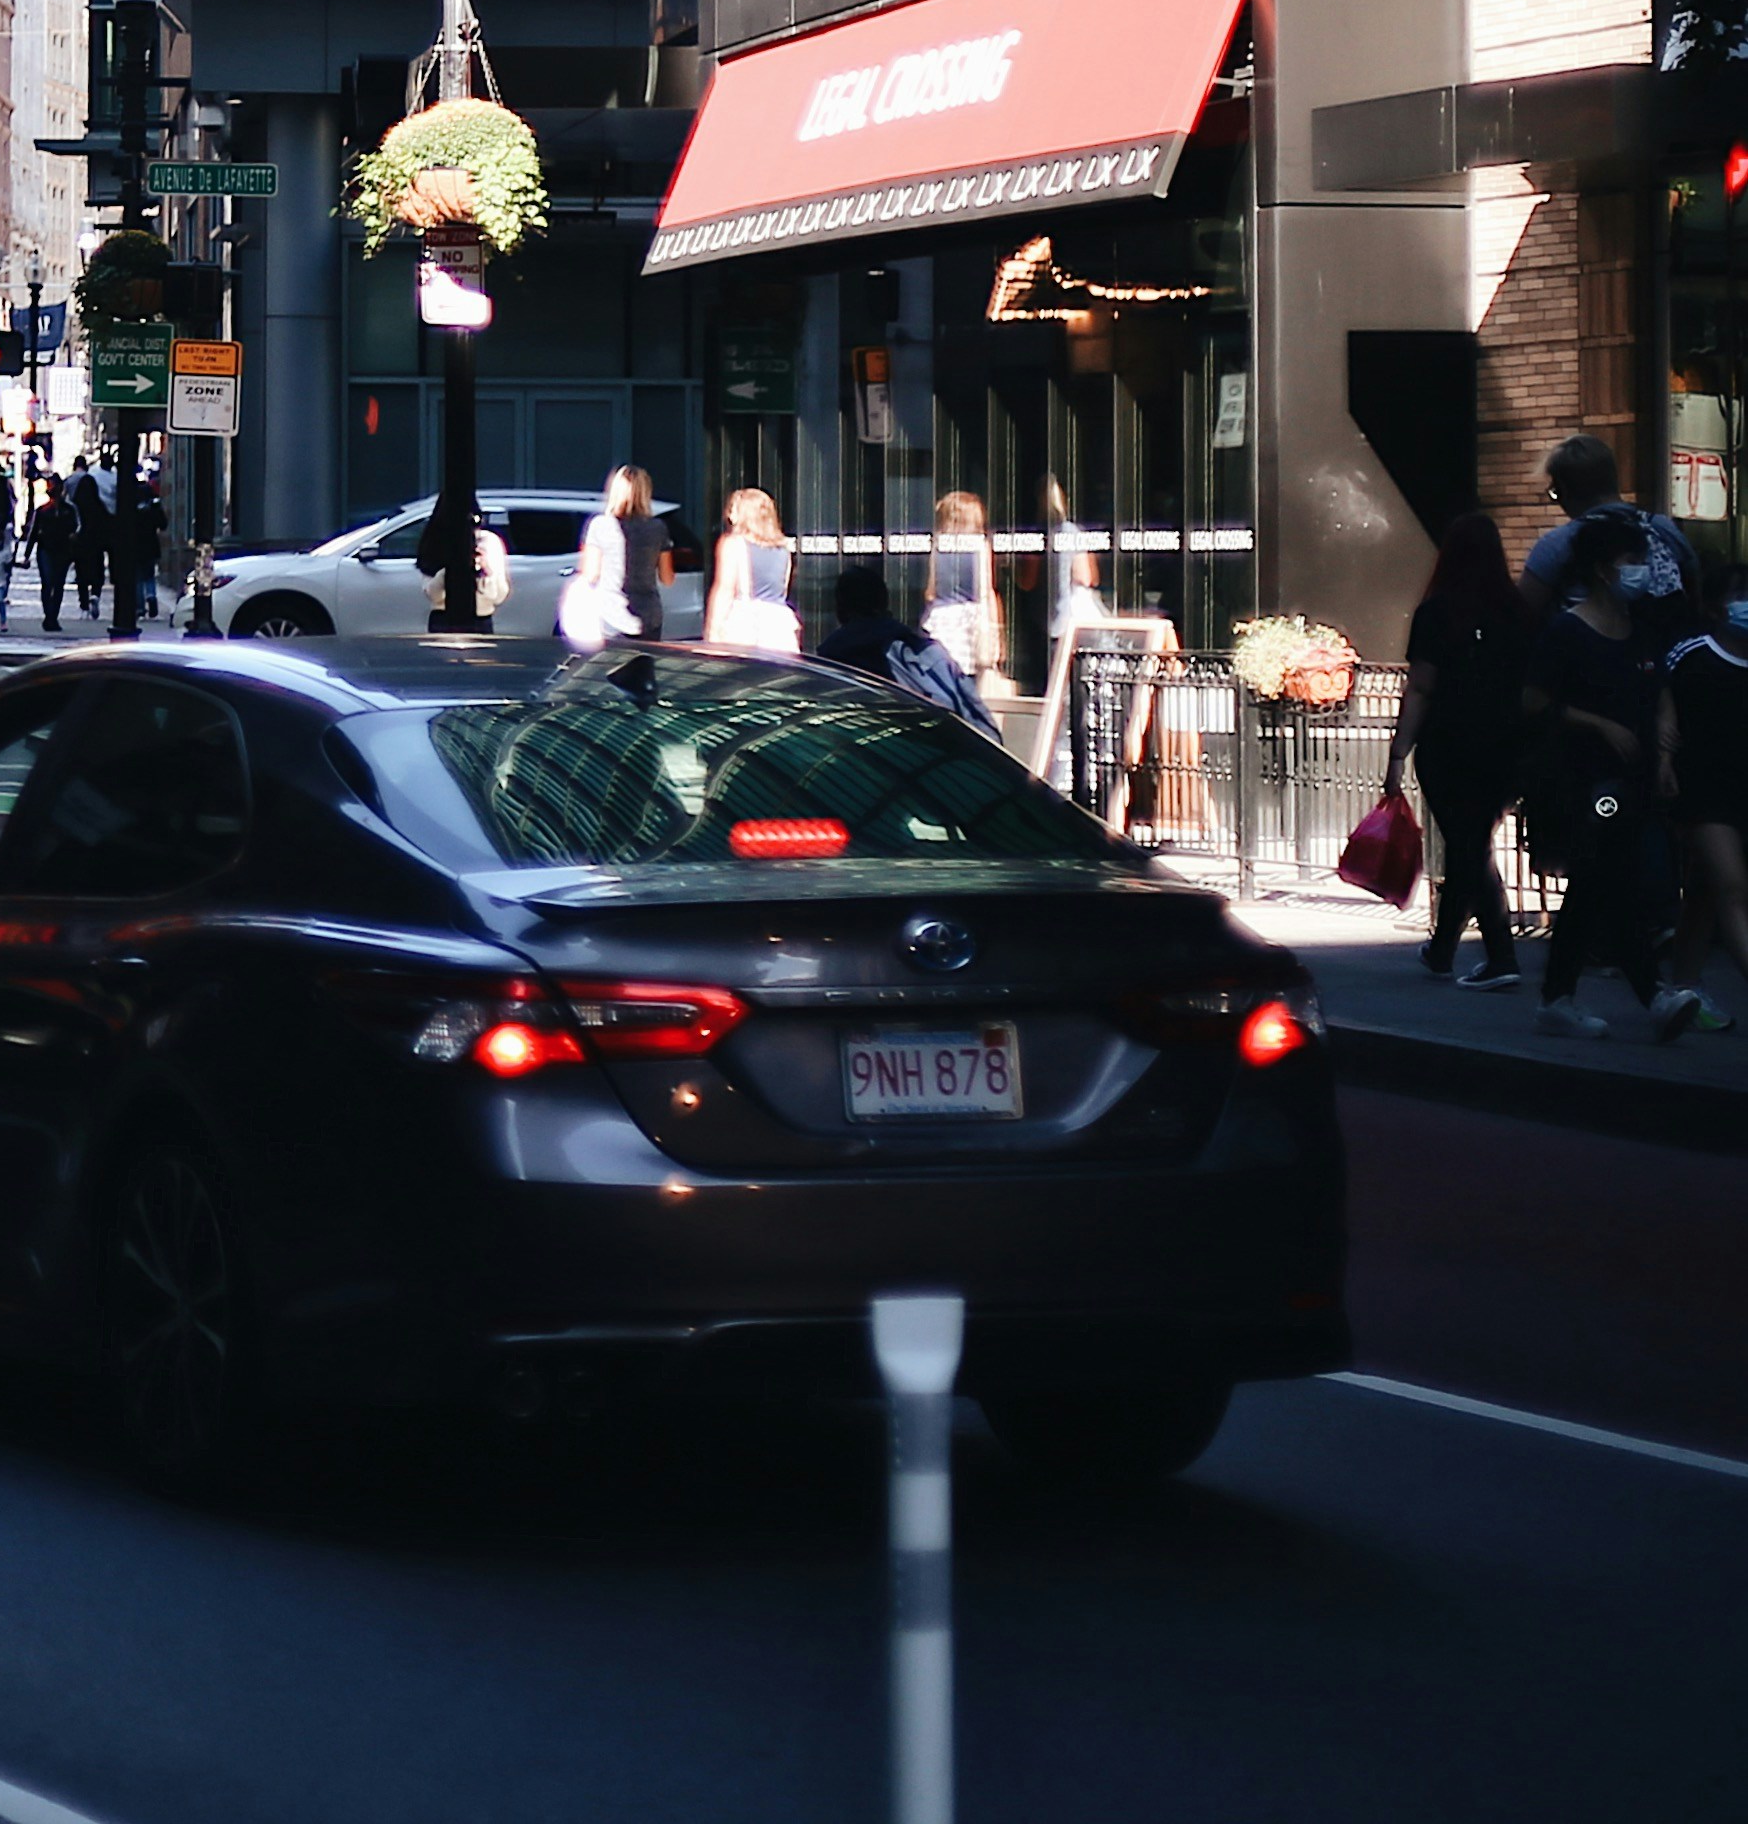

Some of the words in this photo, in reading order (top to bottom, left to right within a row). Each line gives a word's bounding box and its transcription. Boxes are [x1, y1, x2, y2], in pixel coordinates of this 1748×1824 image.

[153, 167, 194, 191] AVENUE
[217, 168, 273, 192] LAFAYETTE
[651, 234, 675, 264] LX
[671, 229, 695, 260] LX
[691, 224, 715, 255] LX
[710, 220, 735, 251] LX
[730, 215, 756, 247] LX
[751, 211, 779, 243] LX
[774, 206, 803, 239] LX
[798, 201, 828, 235] LX
[824, 197, 855, 230] LX
[852, 192, 882, 226] LX
[880, 186, 912, 221] LX
[910, 181, 944, 217] LX
[942, 176, 977, 213] LX
[975, 171, 1012, 207] LX
[1010, 164, 1047, 202] LX
[1044, 159, 1082, 196] LX
[1080, 153, 1120, 191] LX
[1119, 146, 1160, 185] LX
[128, 354, 166, 367] CENTER
[185, 387, 224, 395] ZONE
[852, 1049, 925, 1098] 9NH
[934, 1048, 1009, 1096] 878
